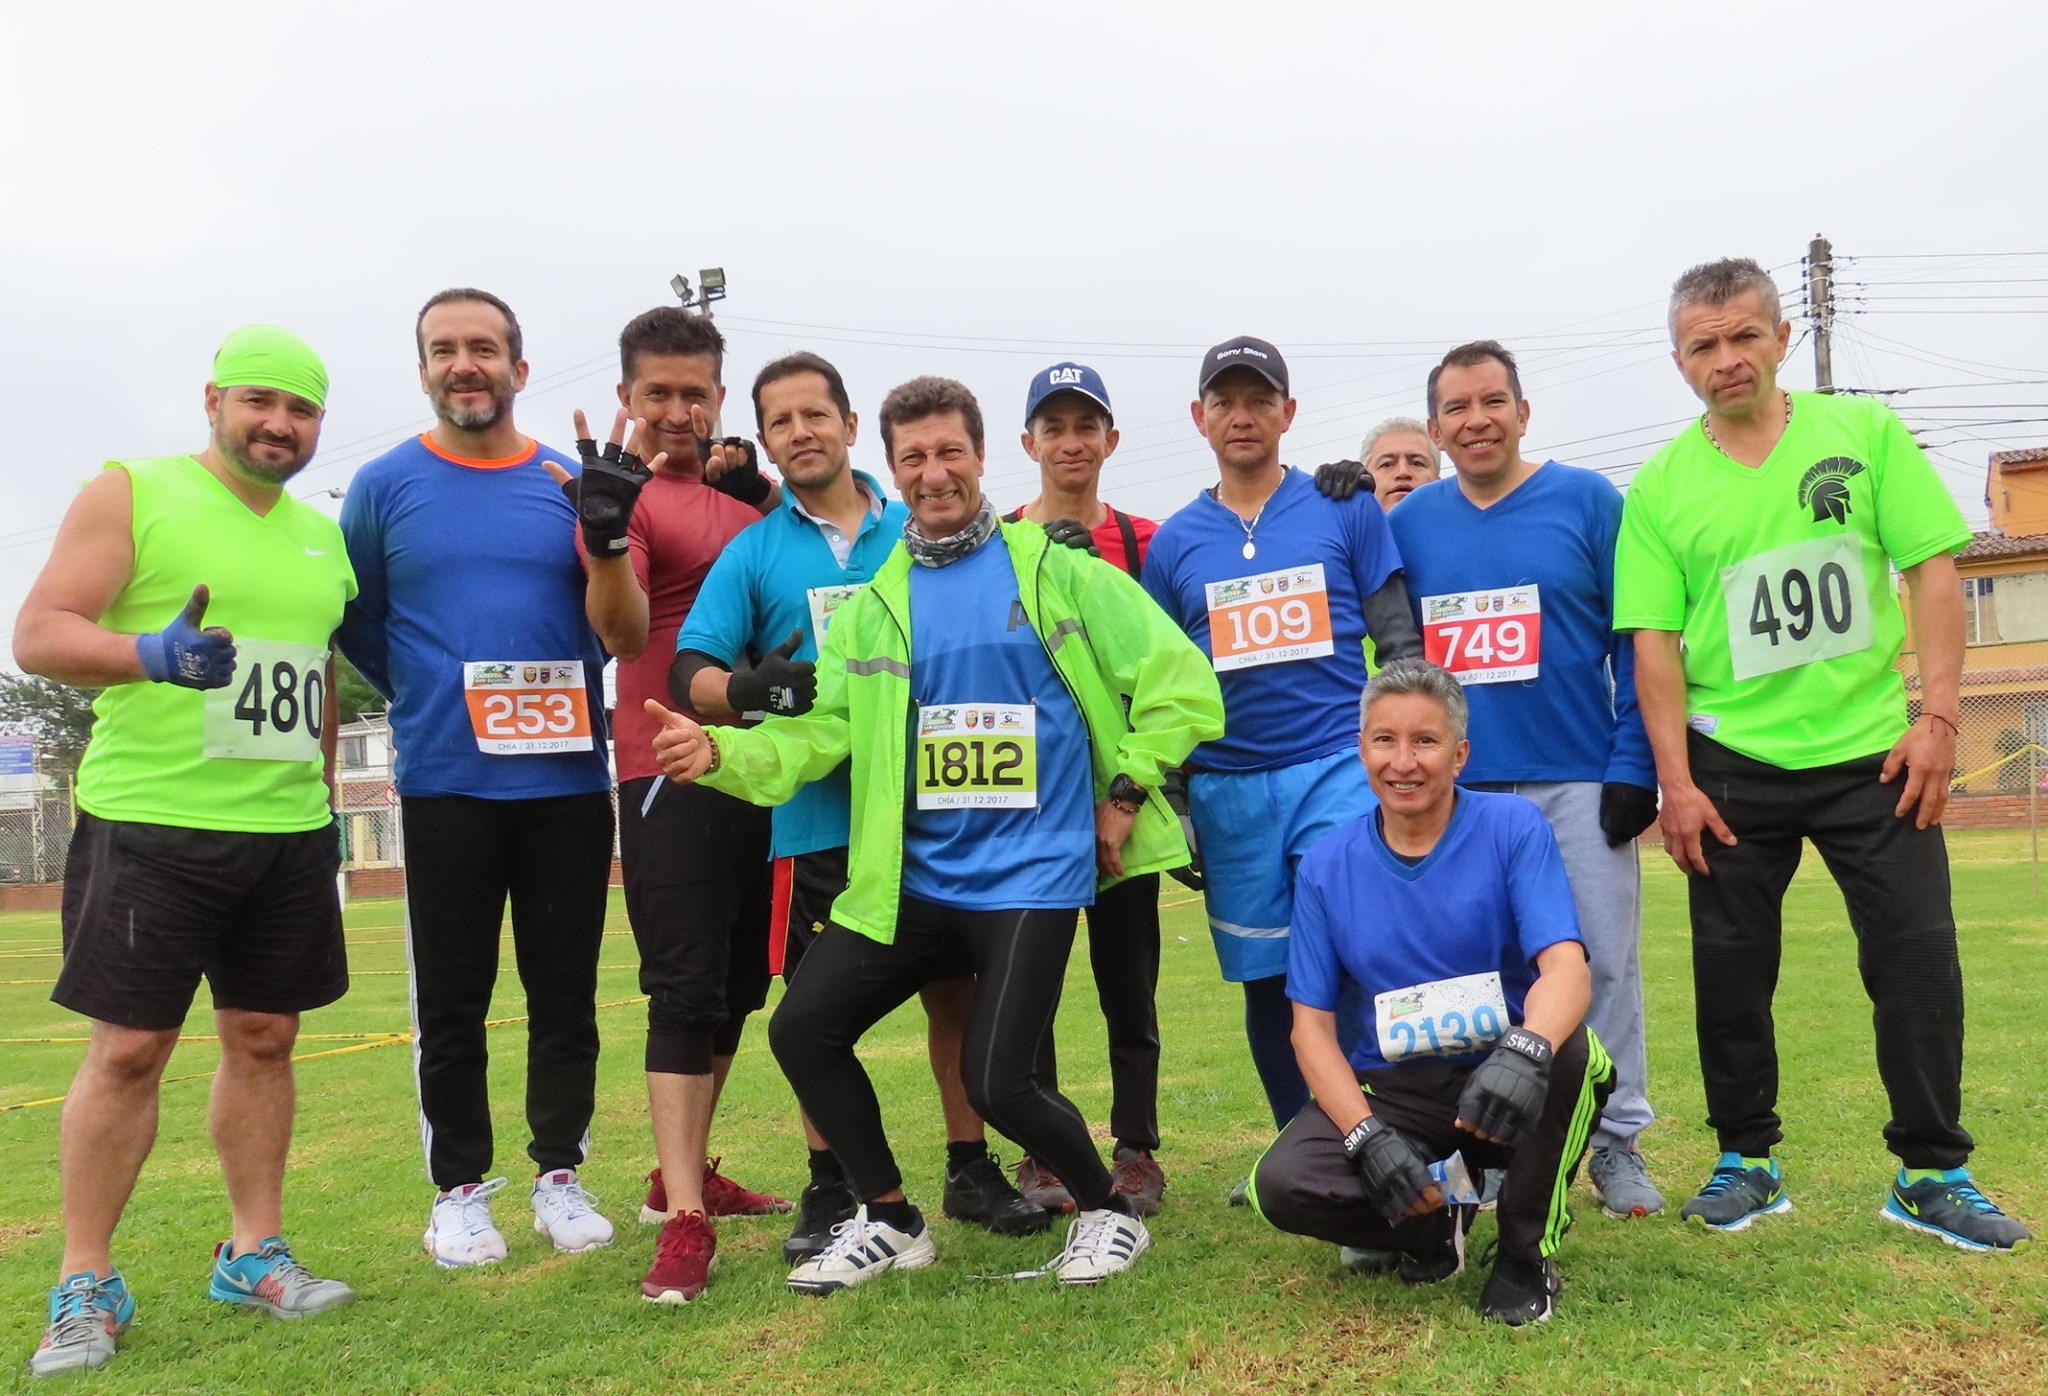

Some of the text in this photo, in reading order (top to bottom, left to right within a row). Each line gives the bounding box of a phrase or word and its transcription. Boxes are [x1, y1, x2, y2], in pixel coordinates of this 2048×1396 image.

[1217, 347, 1268, 360] Sony Store
[1049, 367, 1083, 385] CAT
[1749, 562, 1852, 646] 490
[1228, 599, 1312, 650] 109
[1265, 647, 1309, 660] 31.12.2017
[1438, 620, 1526, 668] 749
[234, 661, 323, 739] 480
[484, 693, 576, 735] 253
[526, 741, 569, 750] 31.12.2017
[925, 741, 1024, 787] 1812
[962, 795, 1009, 804] 31.12.2017
[1506, 1033, 1546, 1058] SWAT
[1344, 1121, 1370, 1151] SWAT
